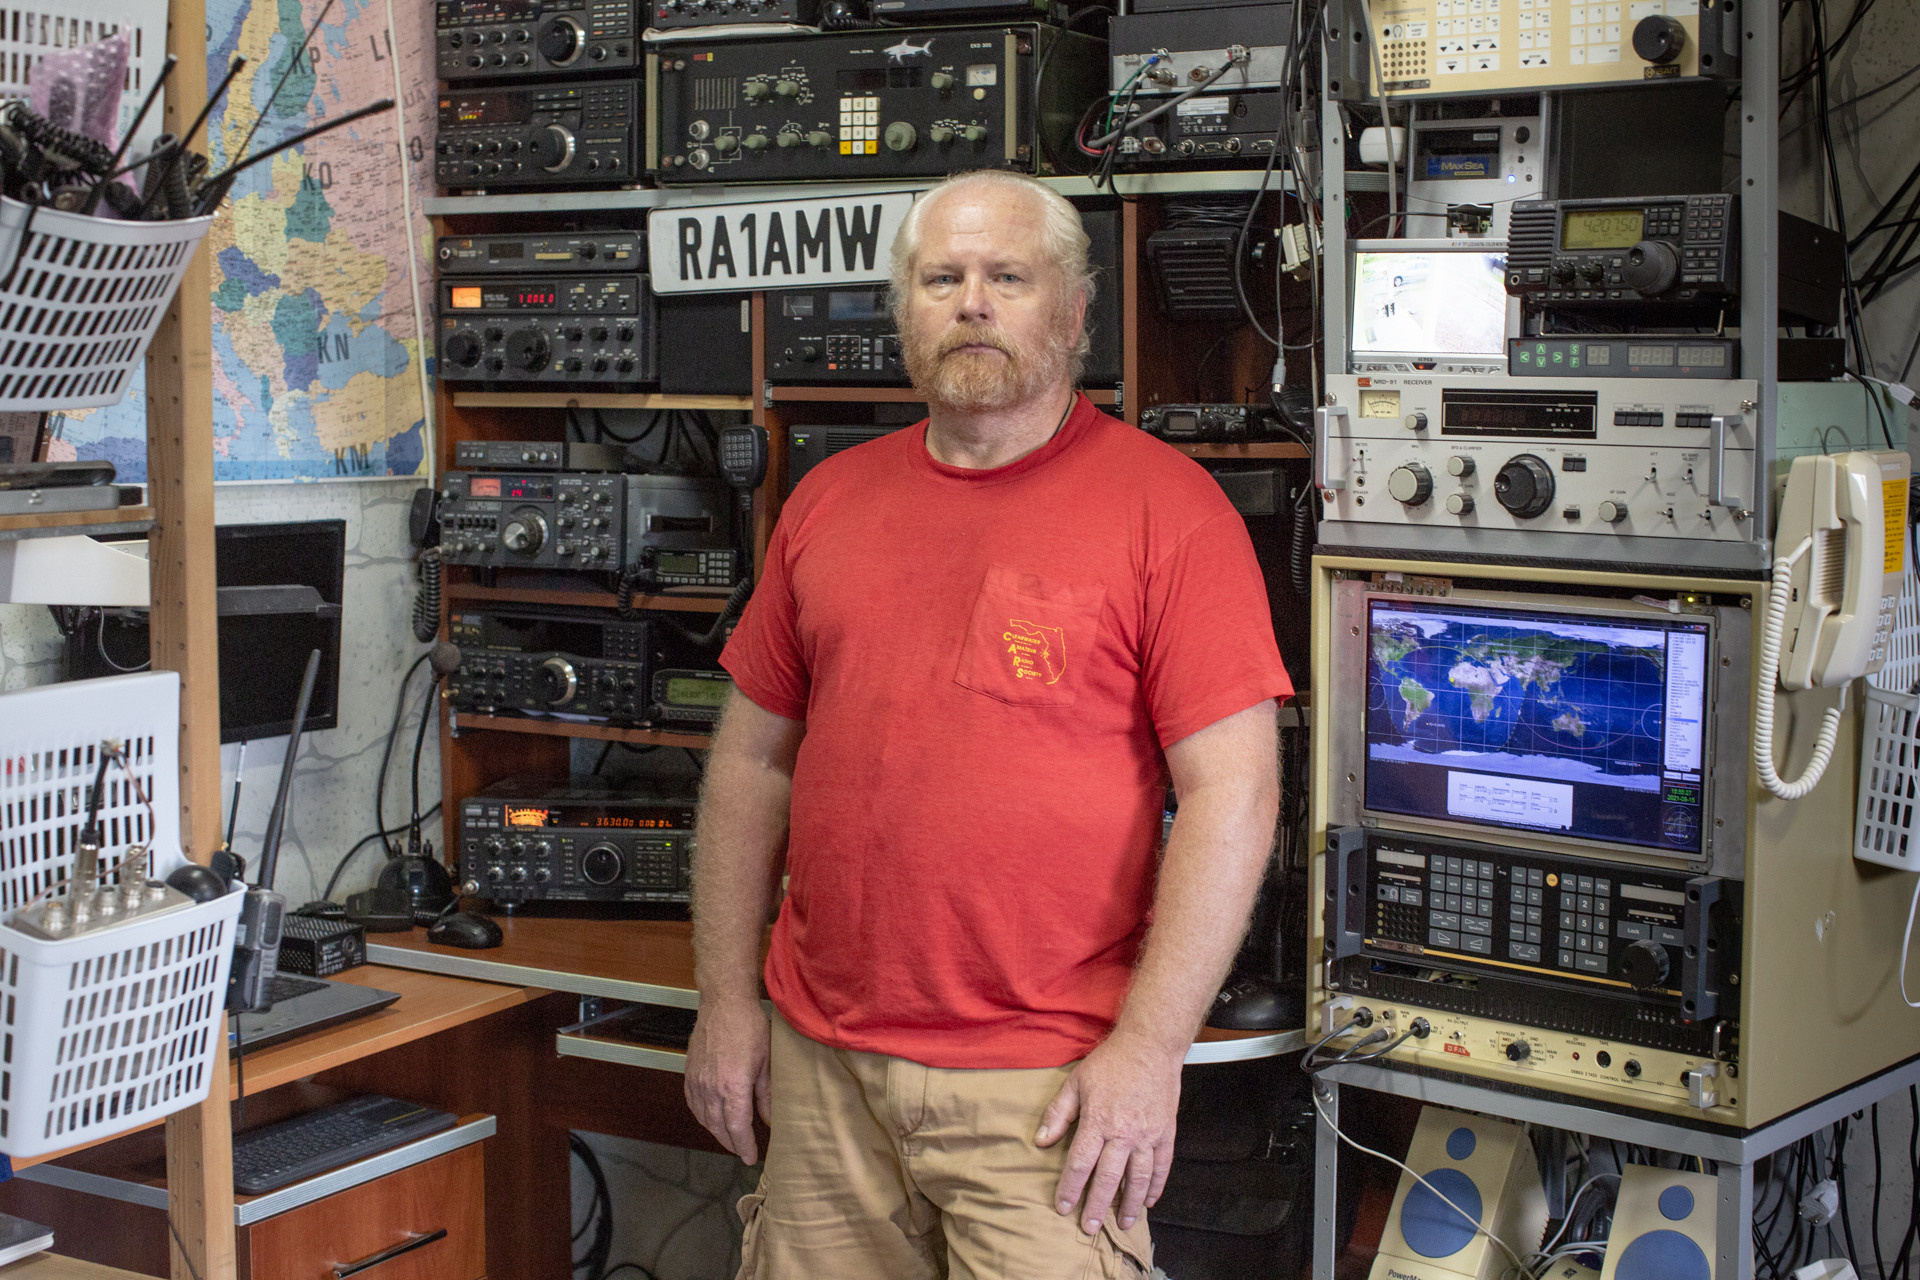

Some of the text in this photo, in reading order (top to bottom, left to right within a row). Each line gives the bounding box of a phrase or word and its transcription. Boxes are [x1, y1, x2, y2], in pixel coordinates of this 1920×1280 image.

[678, 204, 882, 281] RA1AMW
[512, 489, 522, 497] 14
[1662, 932, 1675, 940] Rate
[1584, 959, 1598, 967] Enter
[1565, 1039, 1586, 1047] REQUIRED
[1600, 1074, 1619, 1082] CONTROL
